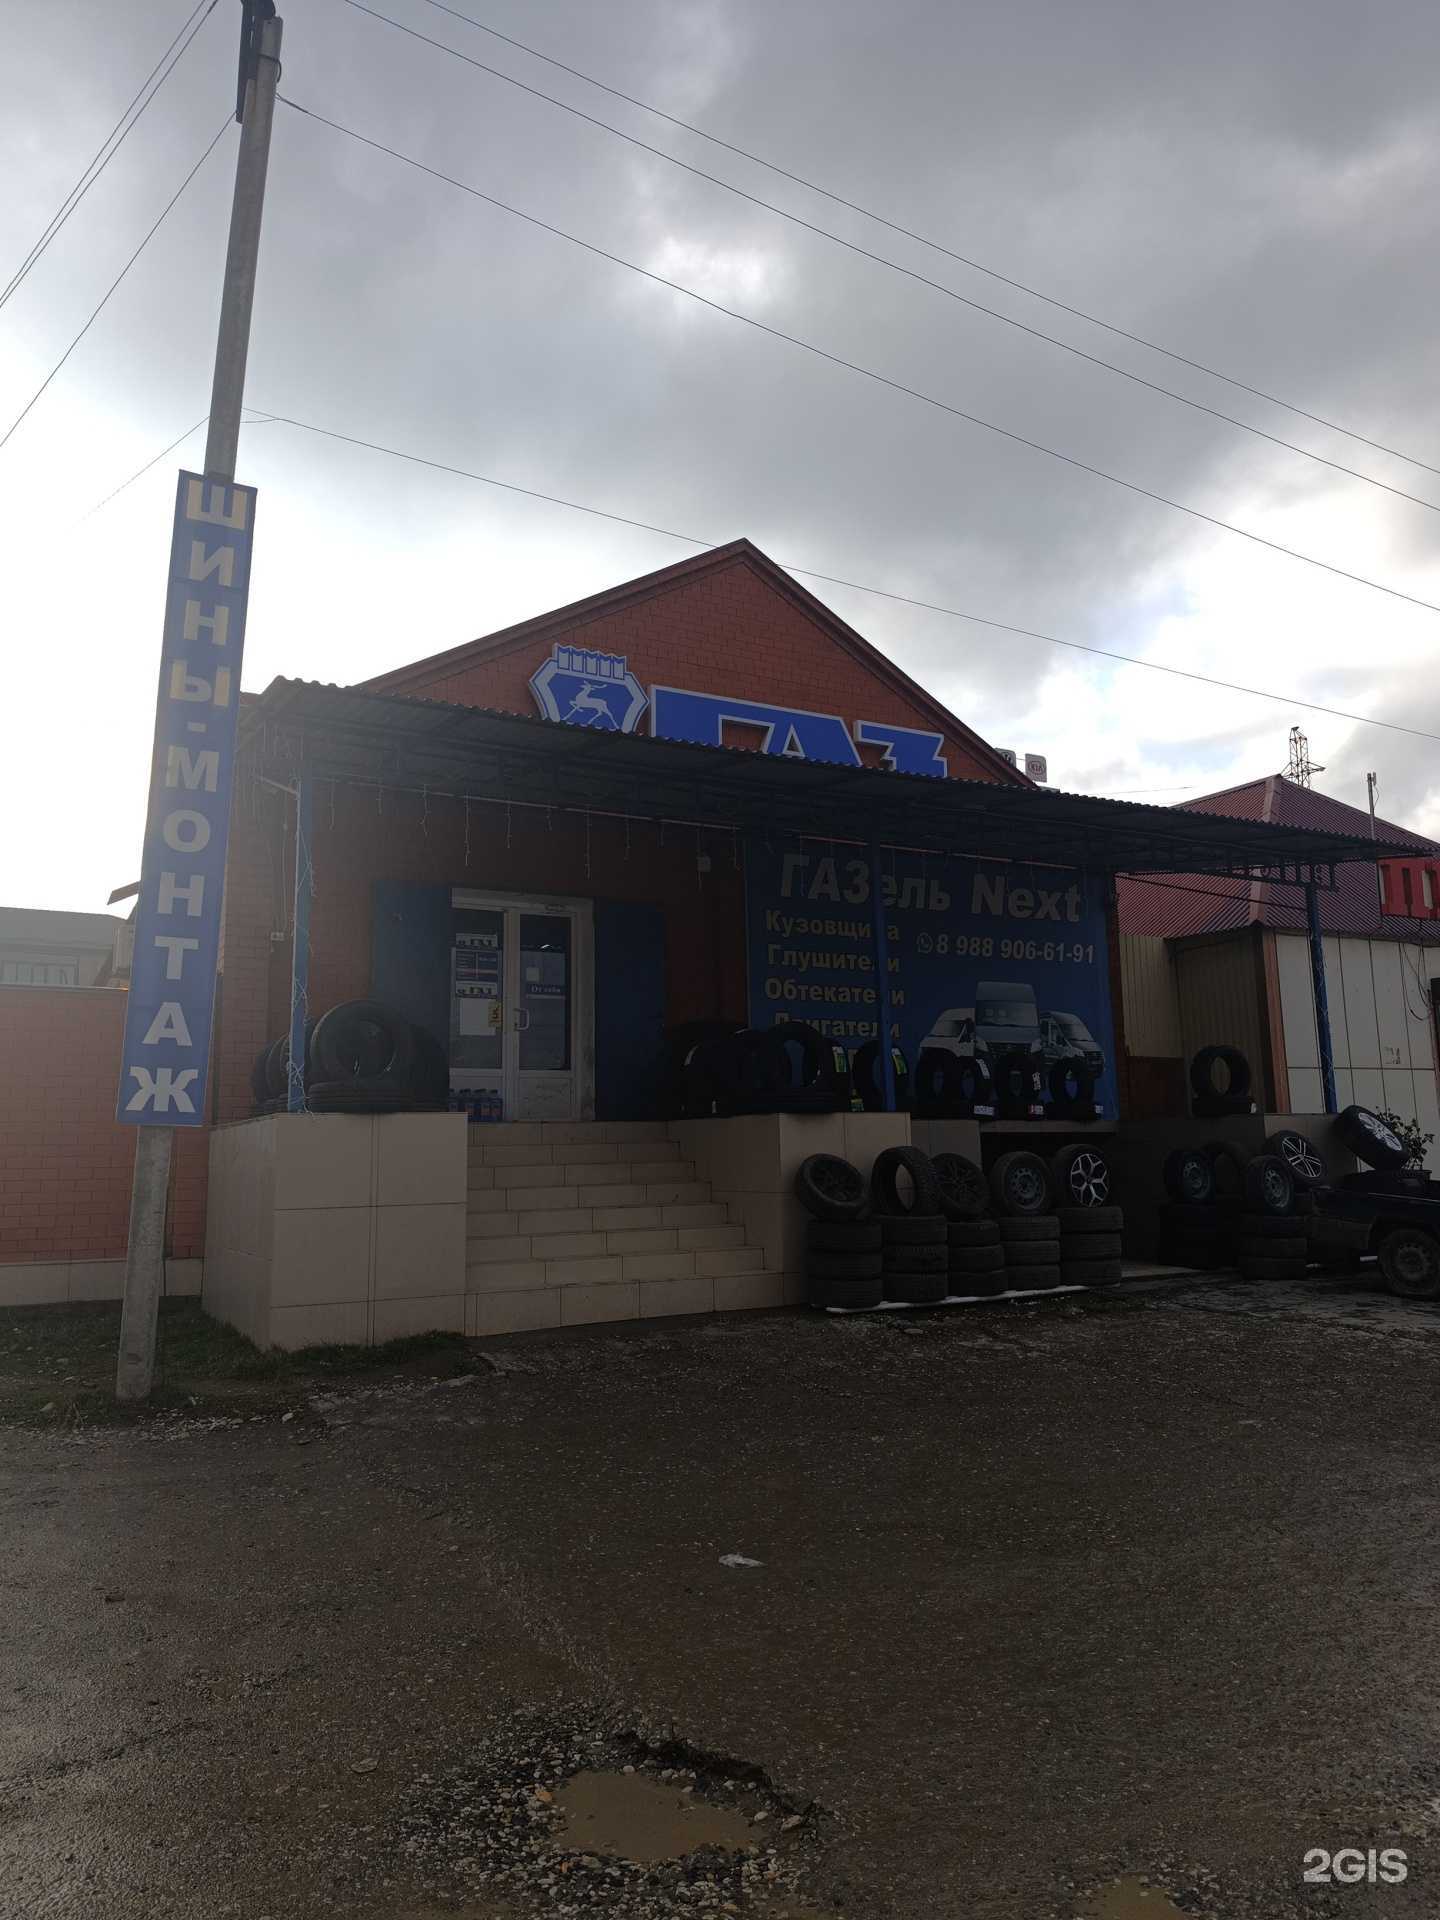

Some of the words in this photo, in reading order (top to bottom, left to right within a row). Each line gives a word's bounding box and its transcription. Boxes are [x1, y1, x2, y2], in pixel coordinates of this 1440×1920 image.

[971, 872, 1080, 922] Next
[766, 910, 899, 940] Кузовщиа
[767, 943, 900, 974] Глушитеи
[937, 933, 949, 954] 8
[956, 935, 993, 958] 988
[1000, 939, 1096, 964] 906-61-91
[765, 977, 904, 1005] Обтекатеи
